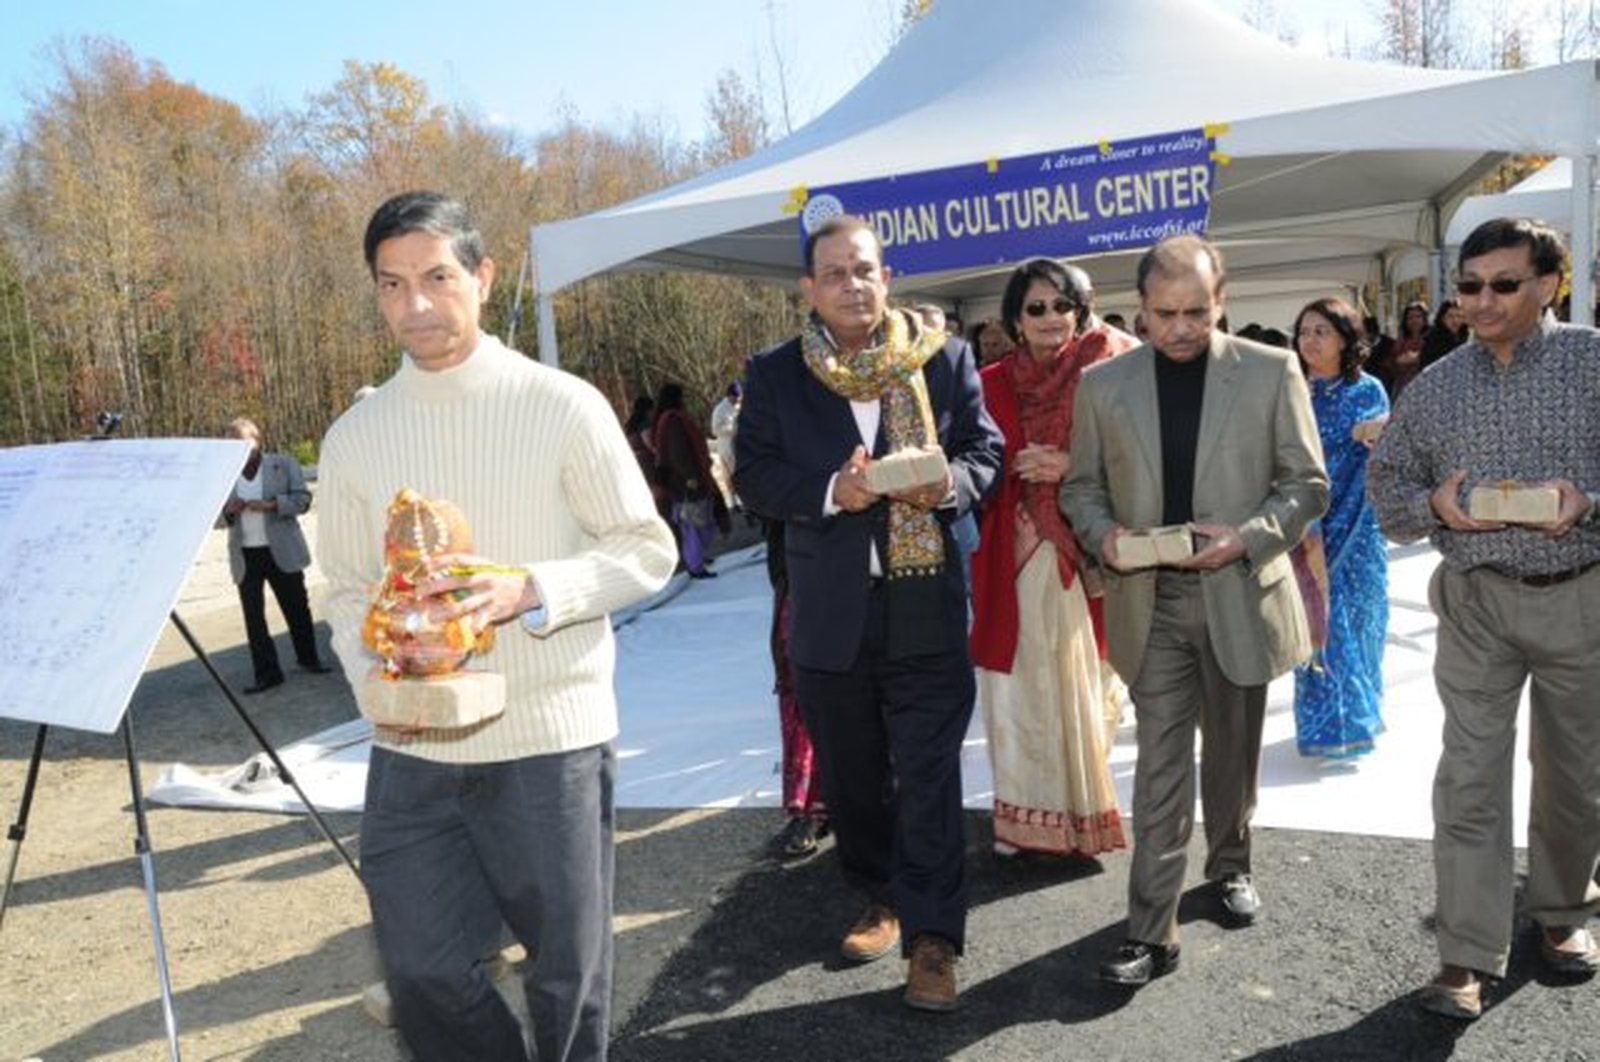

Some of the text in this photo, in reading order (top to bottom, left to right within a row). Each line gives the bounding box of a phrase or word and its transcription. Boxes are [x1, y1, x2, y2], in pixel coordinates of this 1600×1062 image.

[1040, 158, 1052, 171] A
[1054, 152, 1097, 169] dream
[1142, 145, 1156, 156] to
[858, 165, 1210, 247] DIAN CULTURAL CENTER
